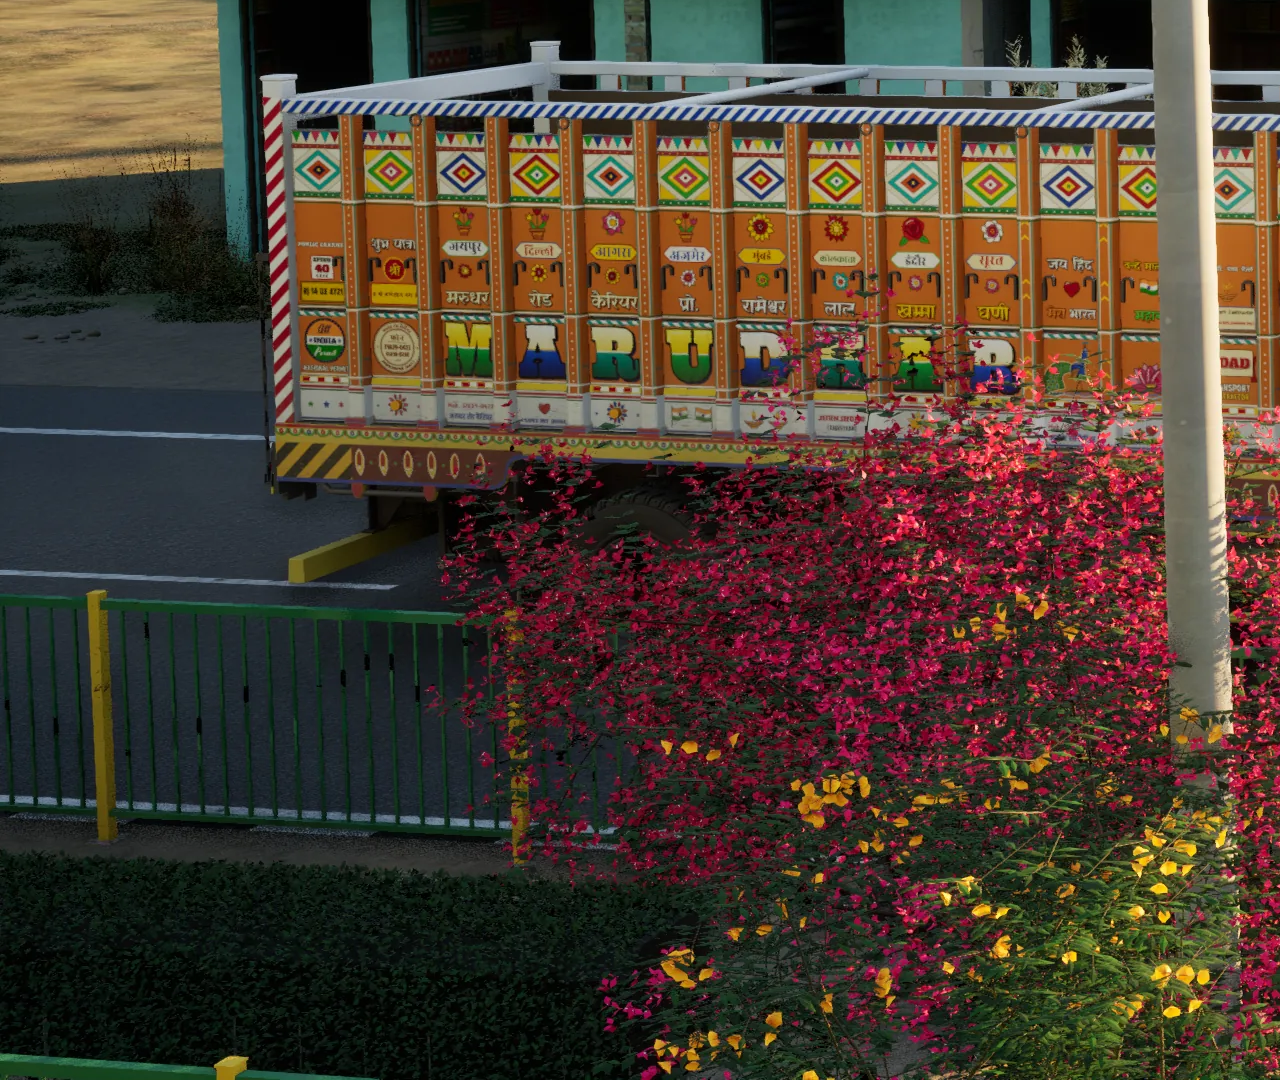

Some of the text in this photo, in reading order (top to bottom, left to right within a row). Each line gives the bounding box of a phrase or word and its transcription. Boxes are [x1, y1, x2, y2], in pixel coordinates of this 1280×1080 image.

[448, 241, 483, 256] जयपुर
[523, 243, 555, 257] दिल्ली
[669, 247, 706, 263] अजमेर
[818, 252, 858, 264] कोलकाता
[978, 255, 1005, 270] सूरत
[1045, 256, 1095, 274] जय हिंद
[314, 264, 330, 273] 40
[445, 289, 1011, 321] मरुधर रोड कैरियर प्रो. रामेश्वर लाल खम्मा घणी
[1069, 307, 1097, 321] भारत
